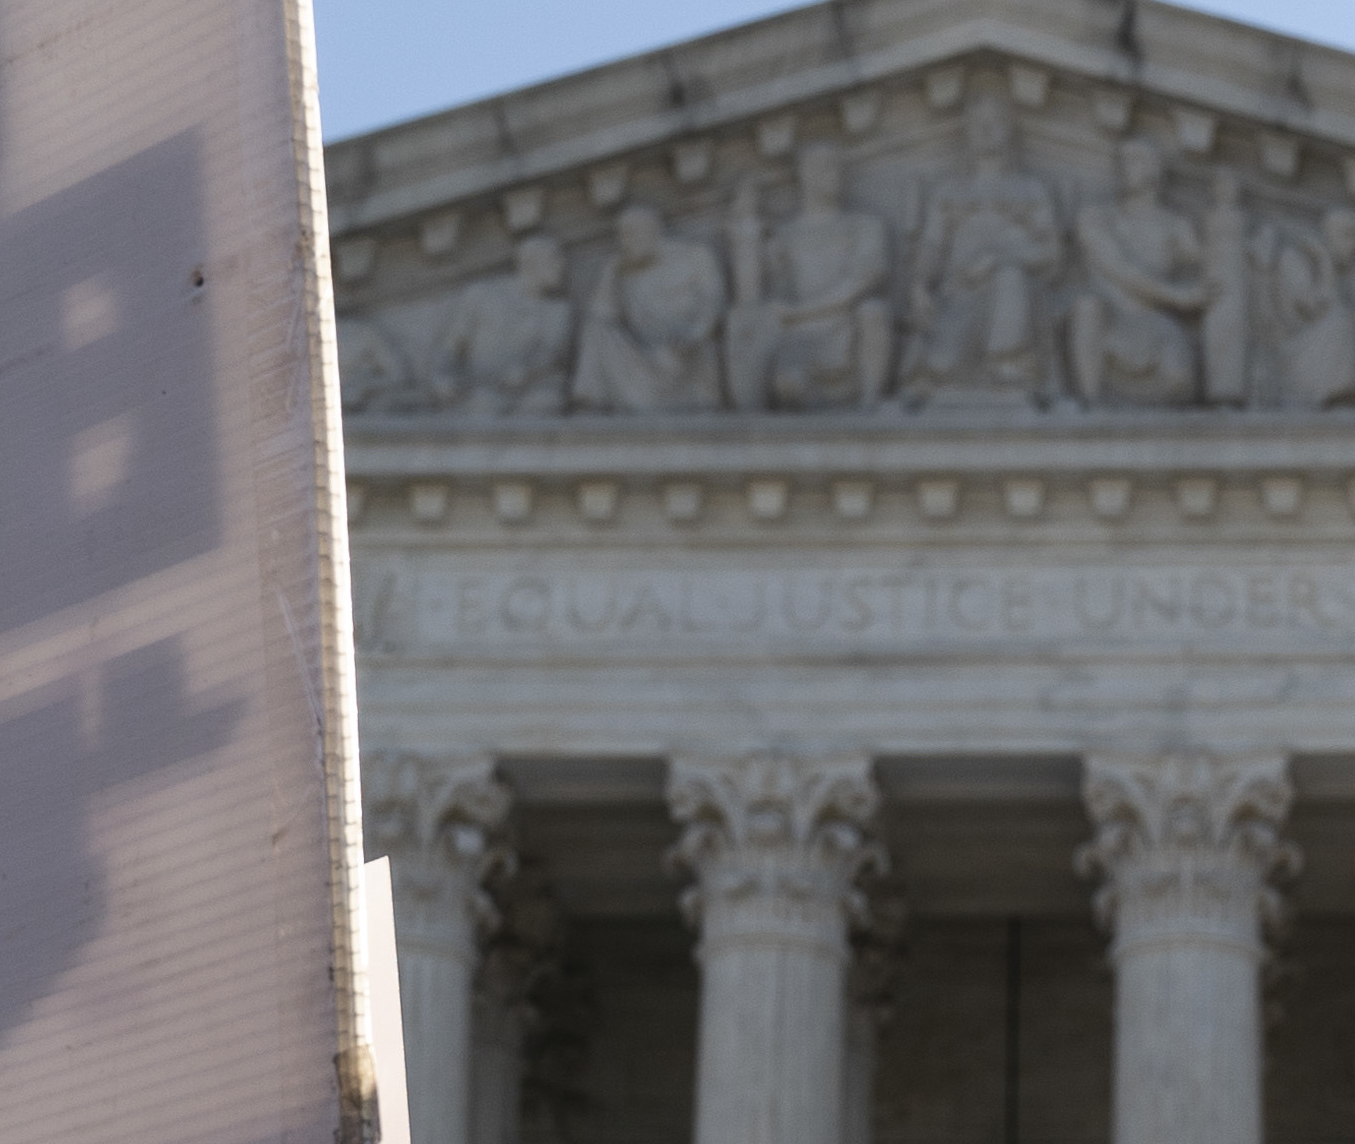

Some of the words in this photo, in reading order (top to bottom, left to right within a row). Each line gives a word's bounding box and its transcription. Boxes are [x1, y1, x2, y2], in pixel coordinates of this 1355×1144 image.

[454, 575, 702, 635] EQUAL
[734, 573, 1036, 635] JUSTICE
[1071, 574, 1341, 632] UNDER
